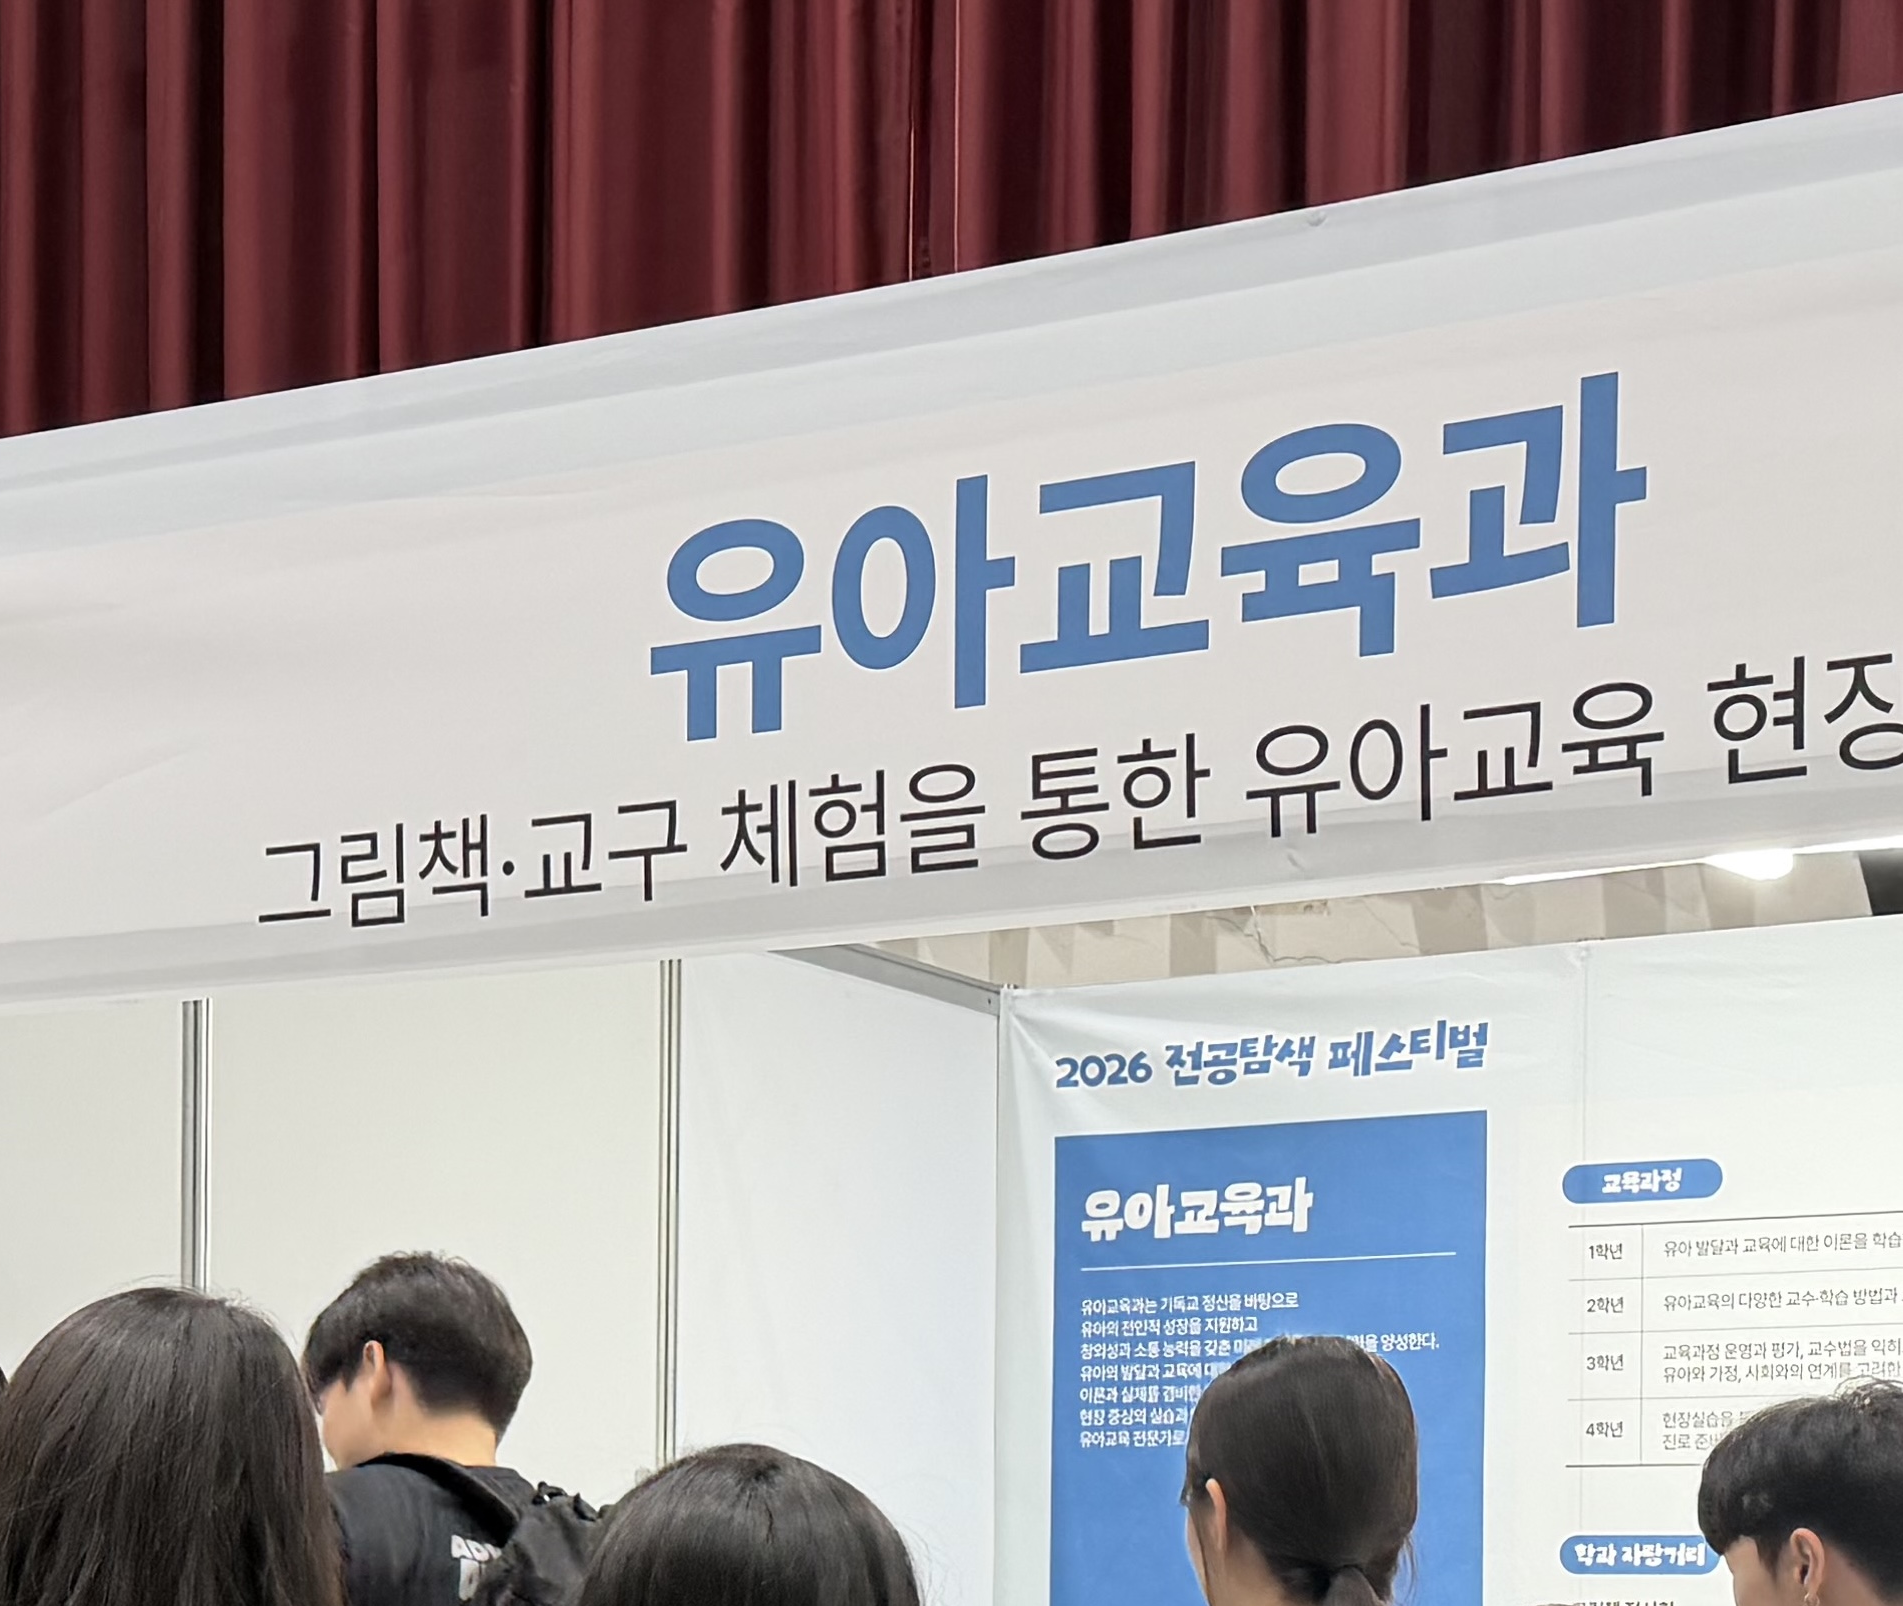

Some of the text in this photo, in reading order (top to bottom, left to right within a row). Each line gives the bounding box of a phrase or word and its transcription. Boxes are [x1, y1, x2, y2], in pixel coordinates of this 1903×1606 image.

[651, 372, 1646, 741] 유아교육과
[257, 810, 688, 928] 그림책·교구
[719, 763, 986, 888] 체험을
[1019, 733, 1211, 861] 통한
[1246, 681, 1664, 838] 유아교육
[1055, 1018, 1488, 1089] 2026 전공탐색 페스티벌
[1601, 1167, 1682, 1195] 교육과정
[1081, 1177, 1313, 1241] 유아교육과
[1588, 1243, 1622, 1260] 1학년
[1664, 1241, 1692, 1257] 유아
[1696, 1240, 1738, 1256] 발달과
[1744, 1237, 1786, 1254] 교육에
[1791, 1235, 1818, 1252] 대한
[1823, 1233, 1867, 1250] 이론을
[1081, 1297, 1157, 1315] 유아교육과는
[1160, 1295, 1199, 1313] 기독교
[1203, 1293, 1241, 1311] 정신을
[1587, 1298, 1623, 1314] 2학년
[1664, 1294, 1734, 1312] 유아교육의
[1739, 1292, 1781, 1308] 다양한
[1853, 1288, 1897, 1305] 방법과
[1081, 1316, 1258, 1336] 유아의 전인적 성장을 지원하고
[1381, 1332, 1439, 1352] 양성한다.
[1664, 1343, 1720, 1360] 교육과정
[1725, 1342, 1767, 1360] 운영과
[1808, 1340, 1867, 1357] 교수법을
[1587, 1355, 1623, 1371] 3학년
[1586, 1421, 1623, 1437] 4학년
[1574, 1543, 1706, 1567] 학과 자랑거리
